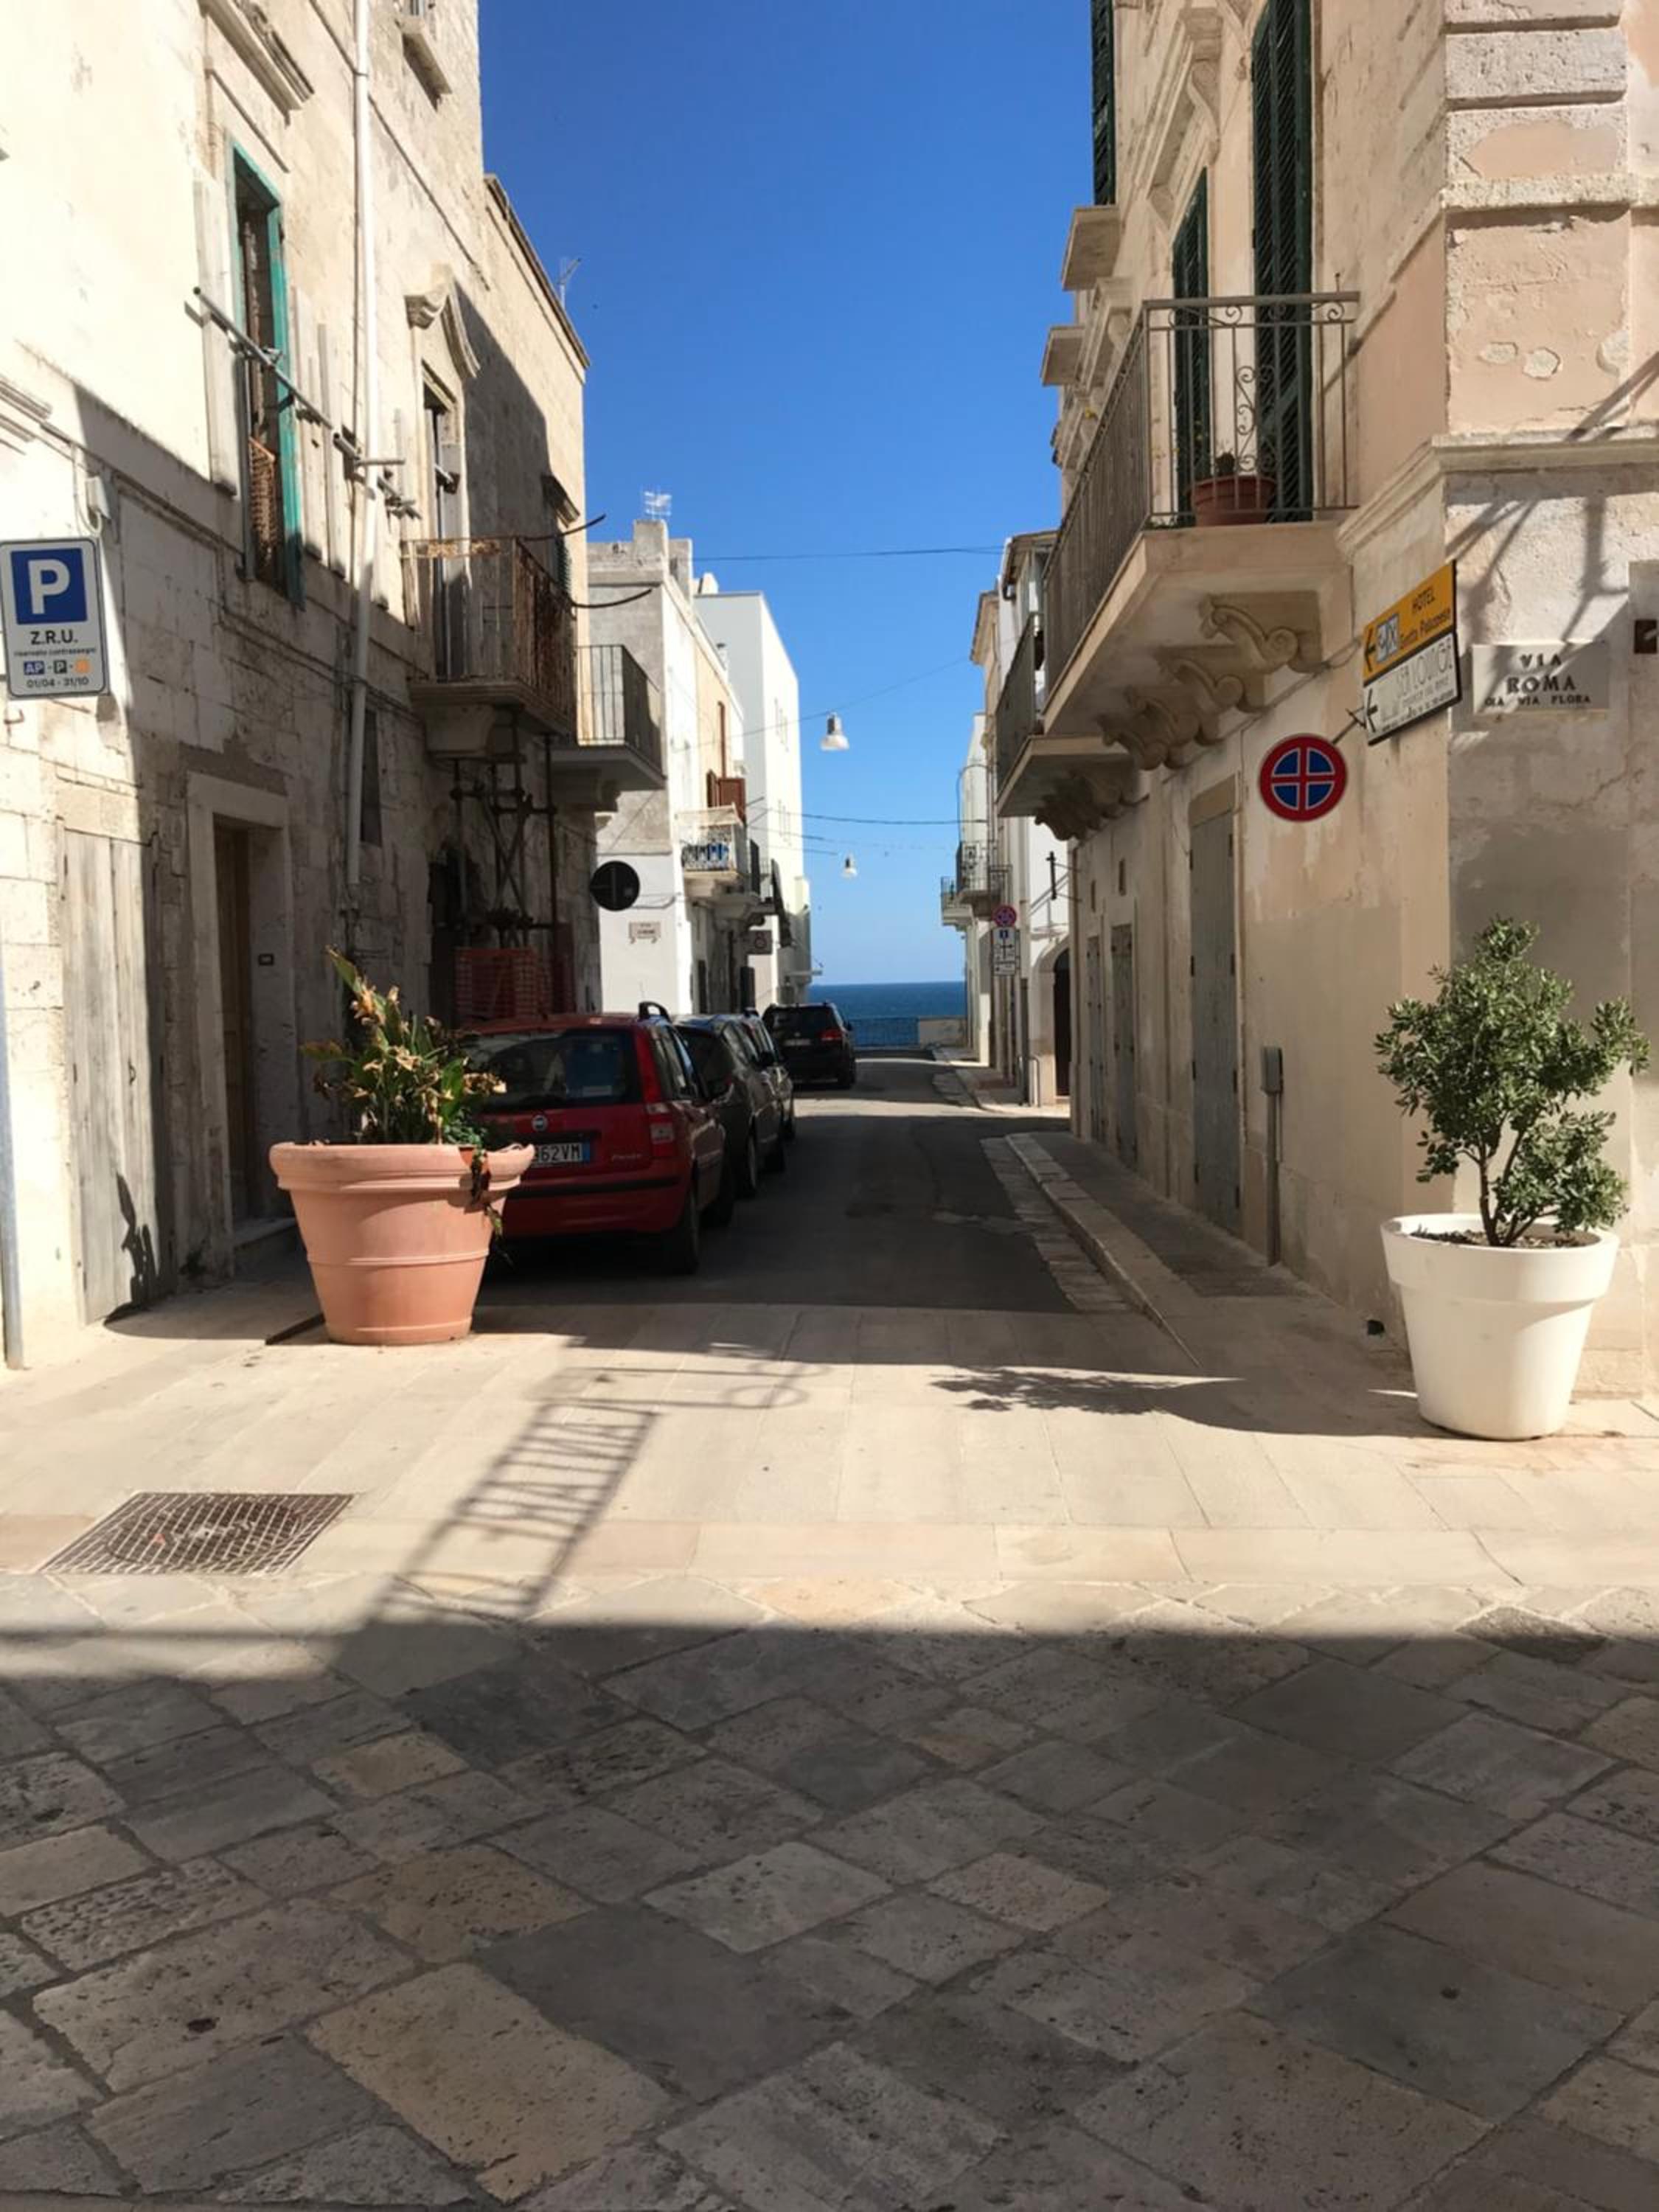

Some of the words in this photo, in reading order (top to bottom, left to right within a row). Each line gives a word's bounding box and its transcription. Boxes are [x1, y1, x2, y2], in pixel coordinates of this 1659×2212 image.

[28, 559, 71, 614] P
[1413, 588, 1435, 611] HOTEL
[30, 629, 78, 645] Z.R.U.
[25, 661, 44, 674] AP
[1520, 653, 1562, 669] VIA
[1506, 674, 1576, 695] ROMA
[1517, 696, 1540, 706] VIA
[1551, 695, 1590, 705] FLORA
